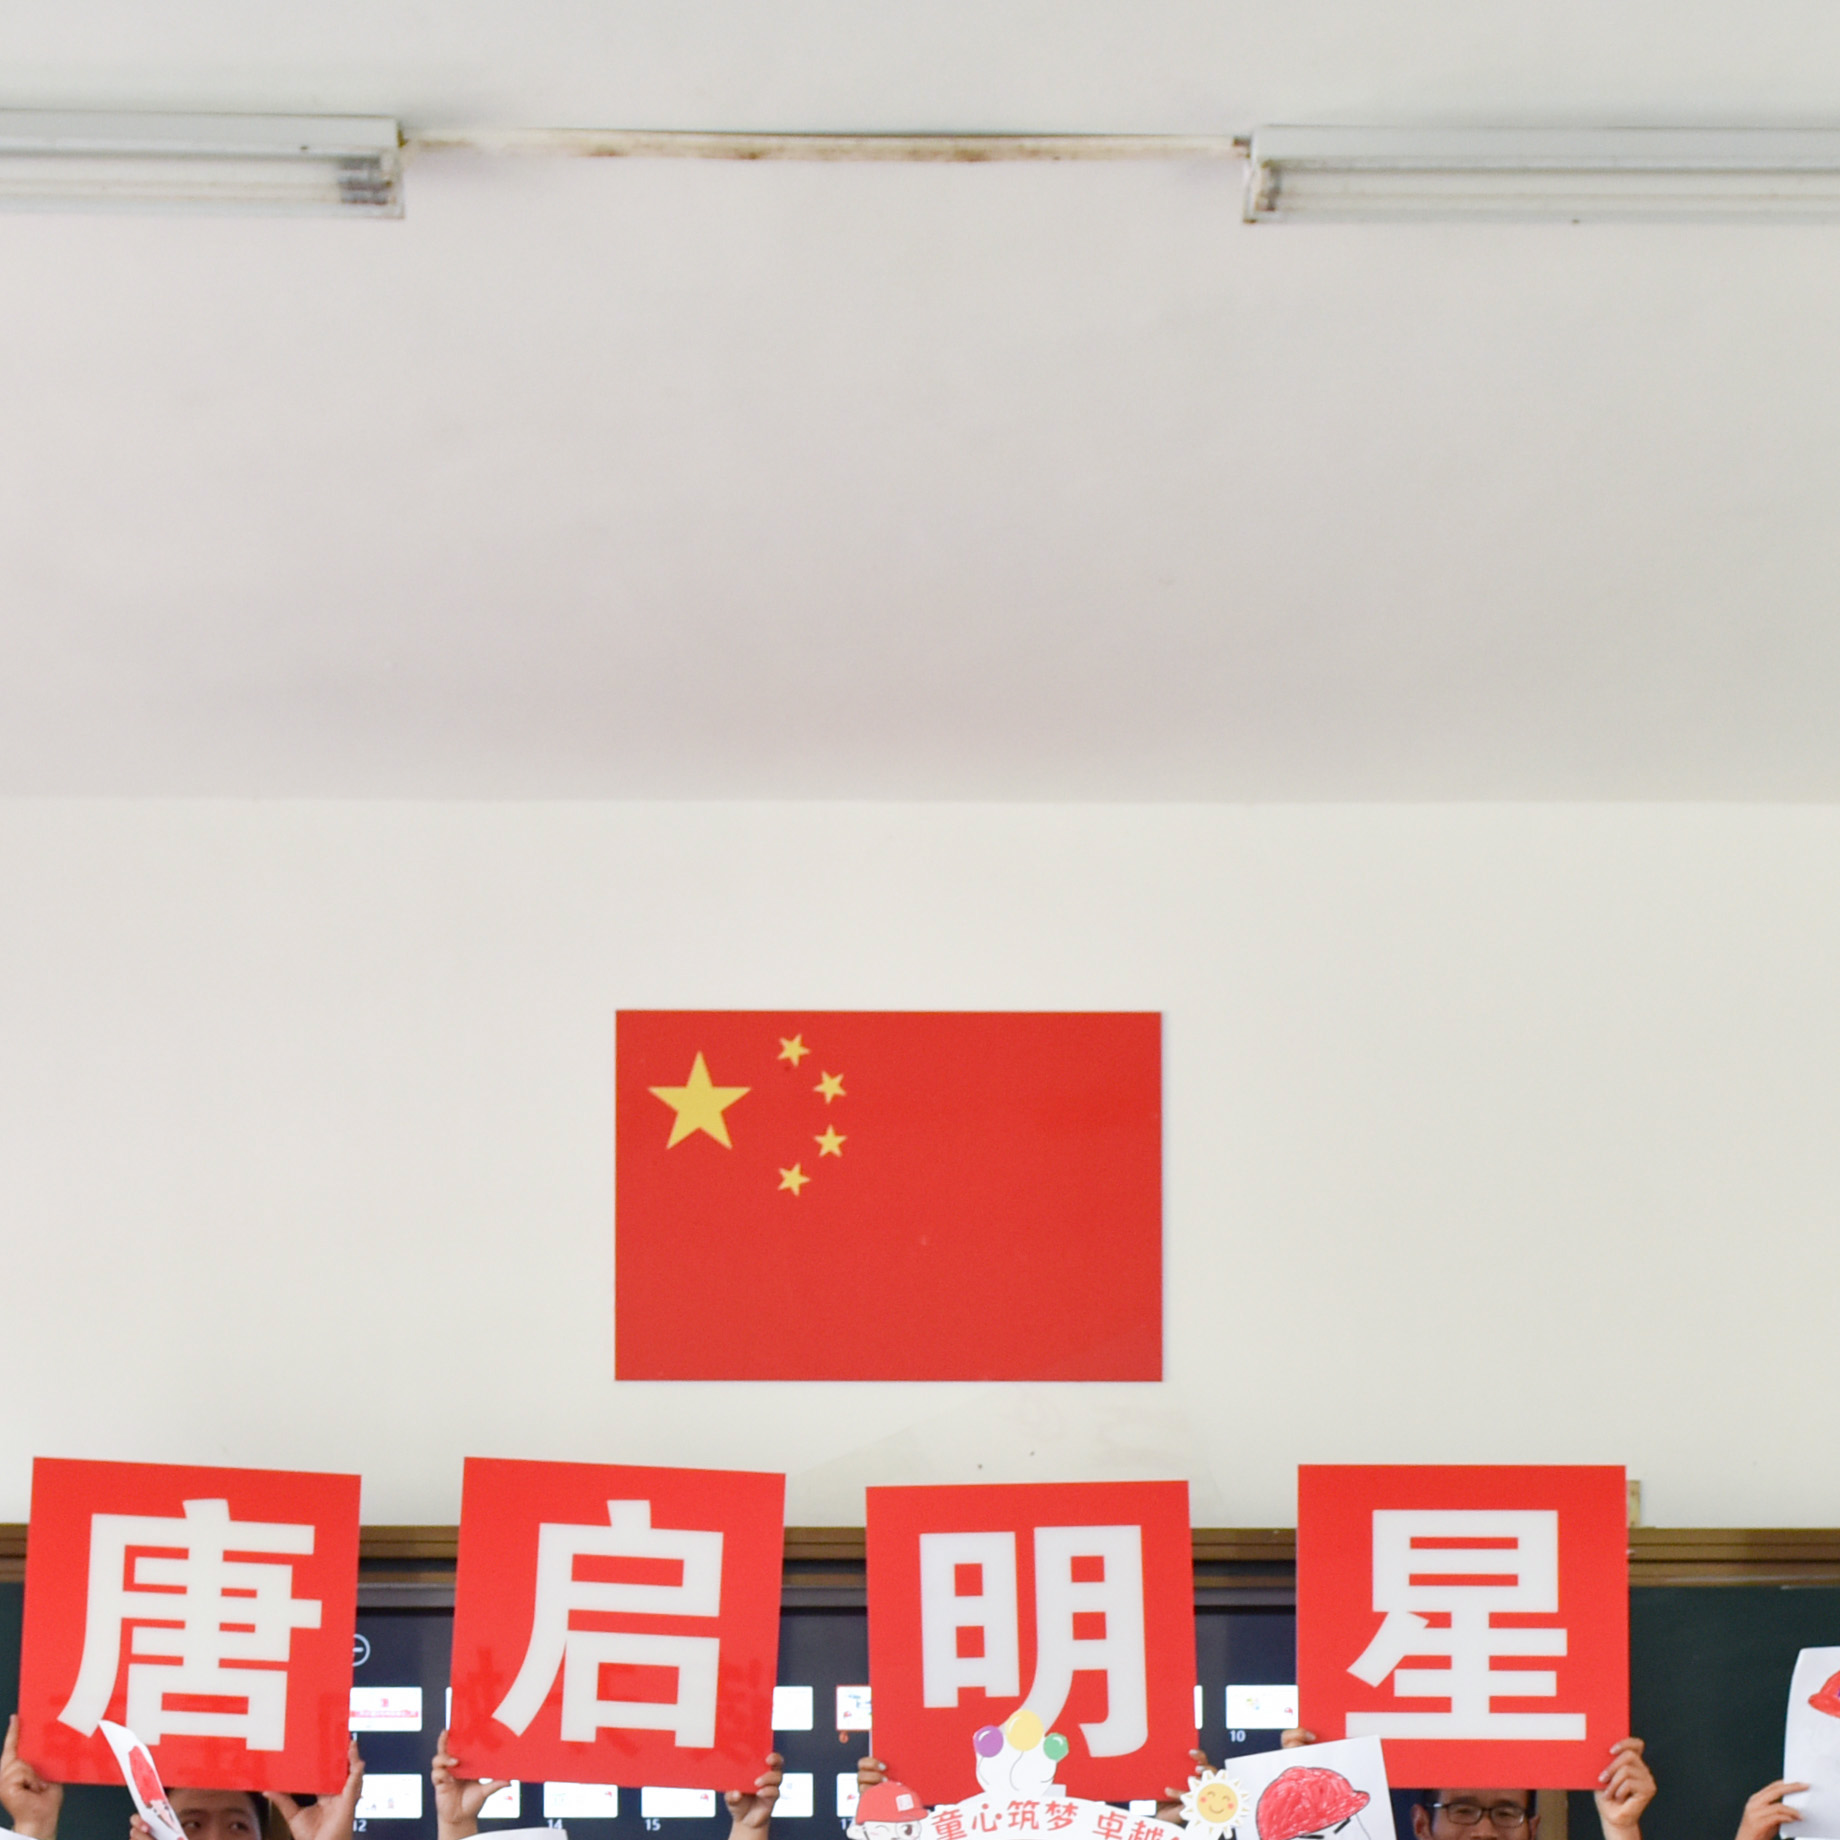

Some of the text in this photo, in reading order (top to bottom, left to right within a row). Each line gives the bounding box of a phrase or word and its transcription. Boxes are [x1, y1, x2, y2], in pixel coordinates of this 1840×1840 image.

[58, 1498, 322, 1751] 唐
[493, 1499, 723, 1749] 启
[919, 1525, 1148, 1758] 明
[1345, 1509, 1586, 1741] 星
[1229, 1730, 1247, 1742] 10
[547, 1818, 562, 1830] 14
[645, 1818, 661, 1831] 15
